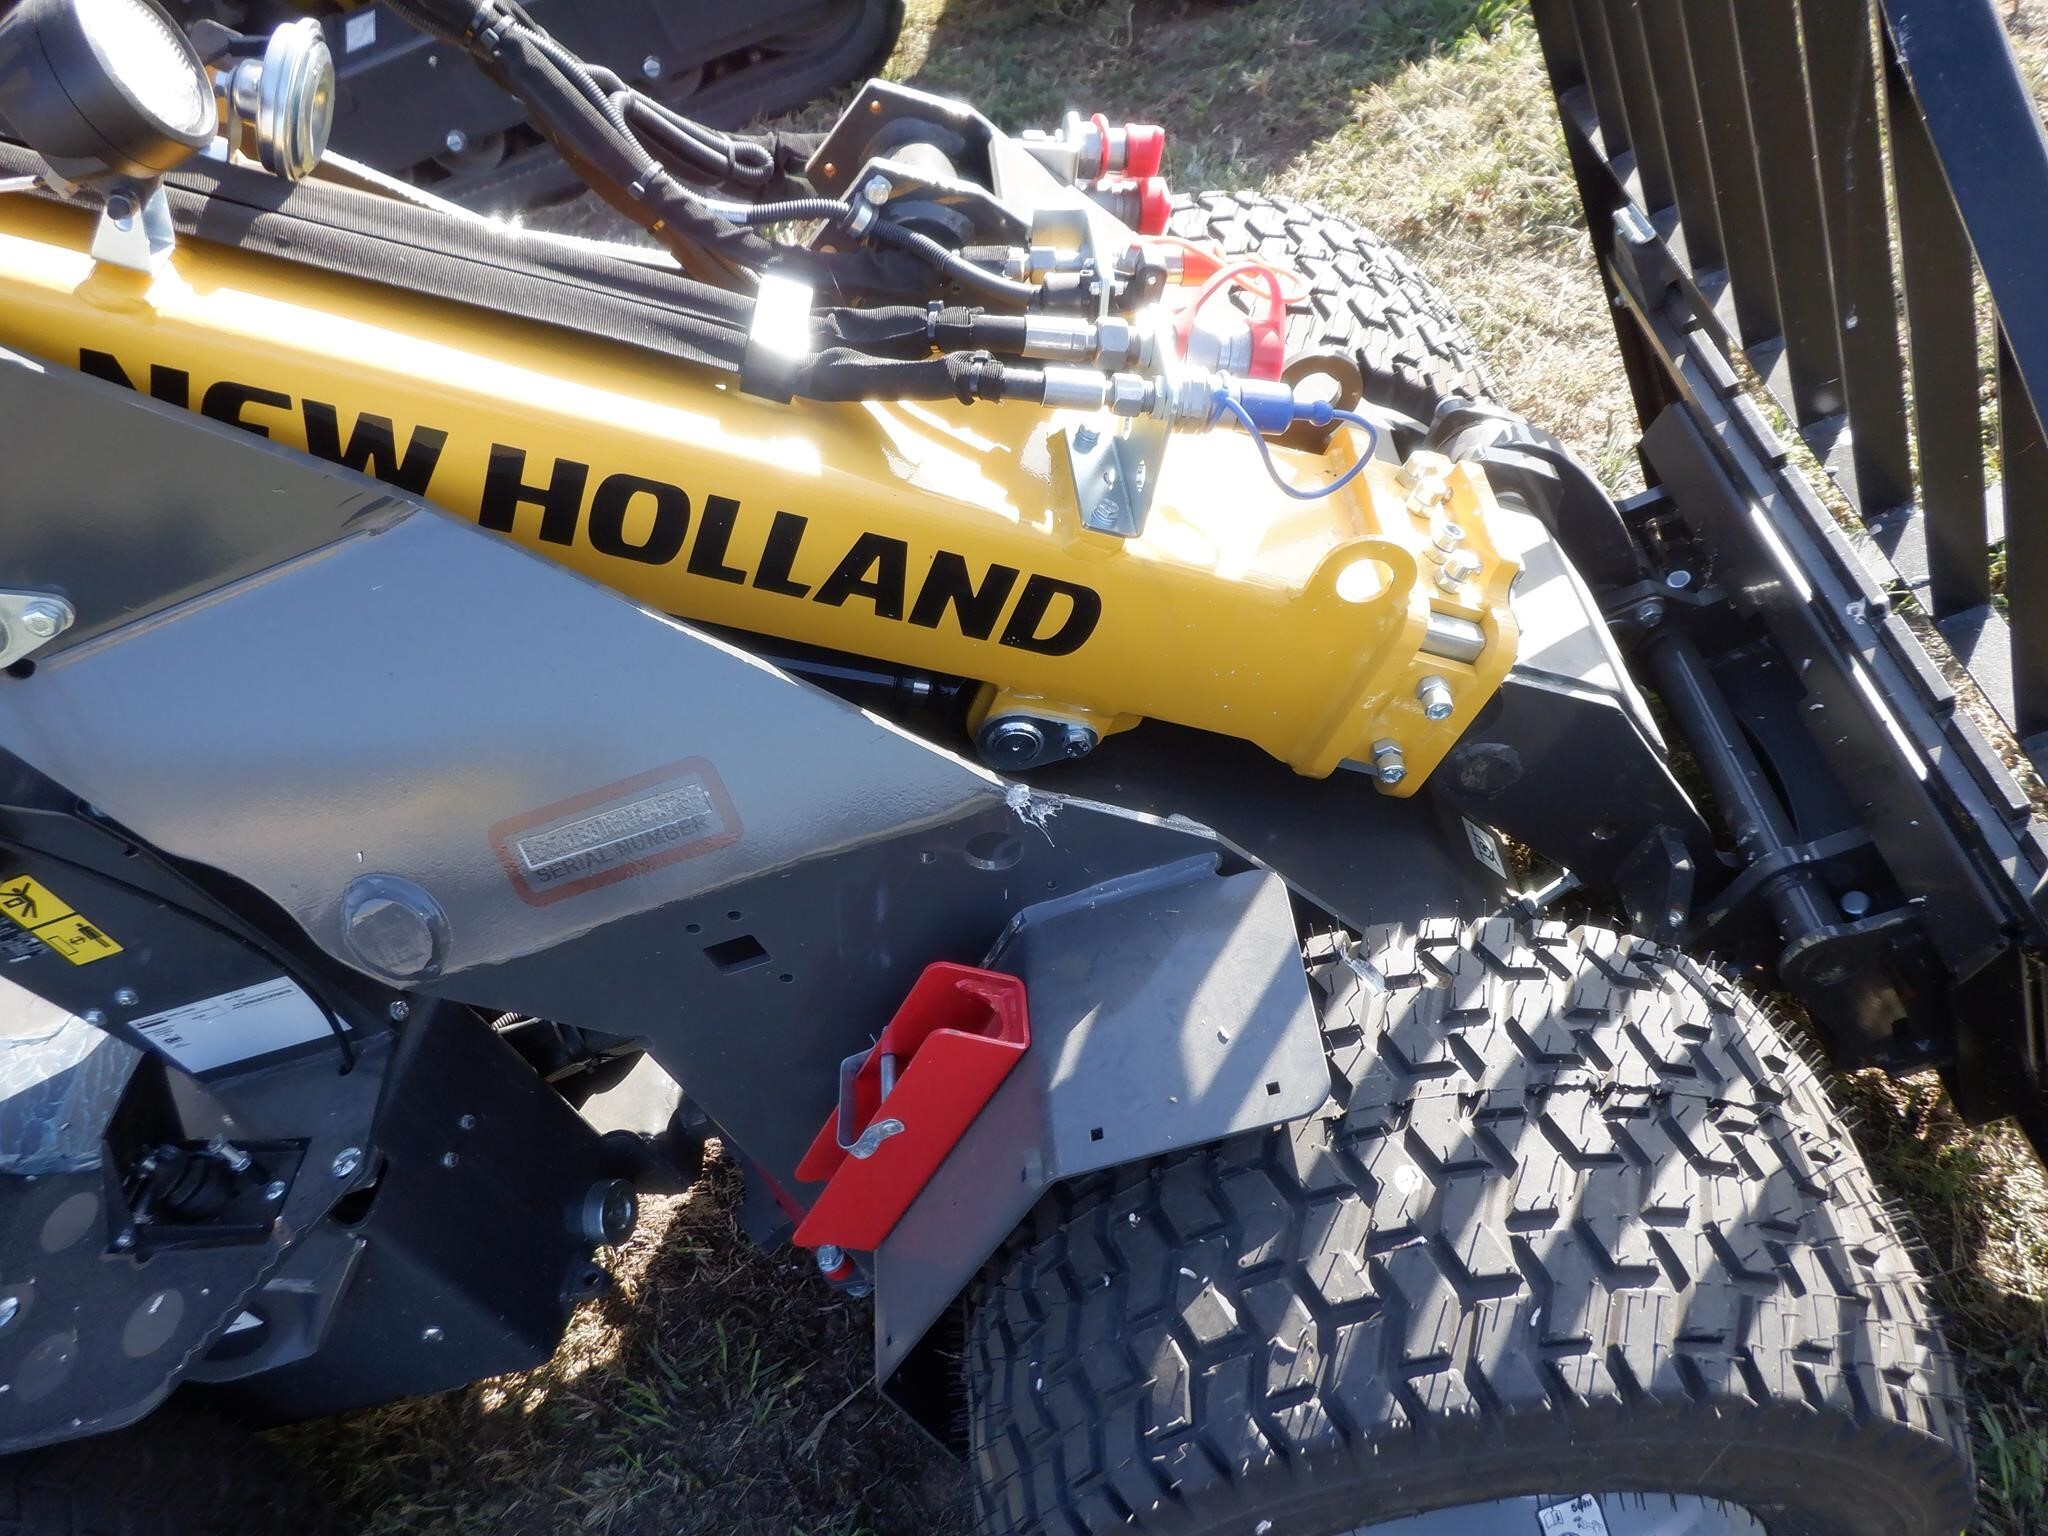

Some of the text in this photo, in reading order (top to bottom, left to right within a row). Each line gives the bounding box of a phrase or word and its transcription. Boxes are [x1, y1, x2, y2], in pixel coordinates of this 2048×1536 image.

[478, 442, 1103, 657] HOLLAND
[536, 848, 614, 882] SERIAL
[615, 817, 710, 854] NUMBER
